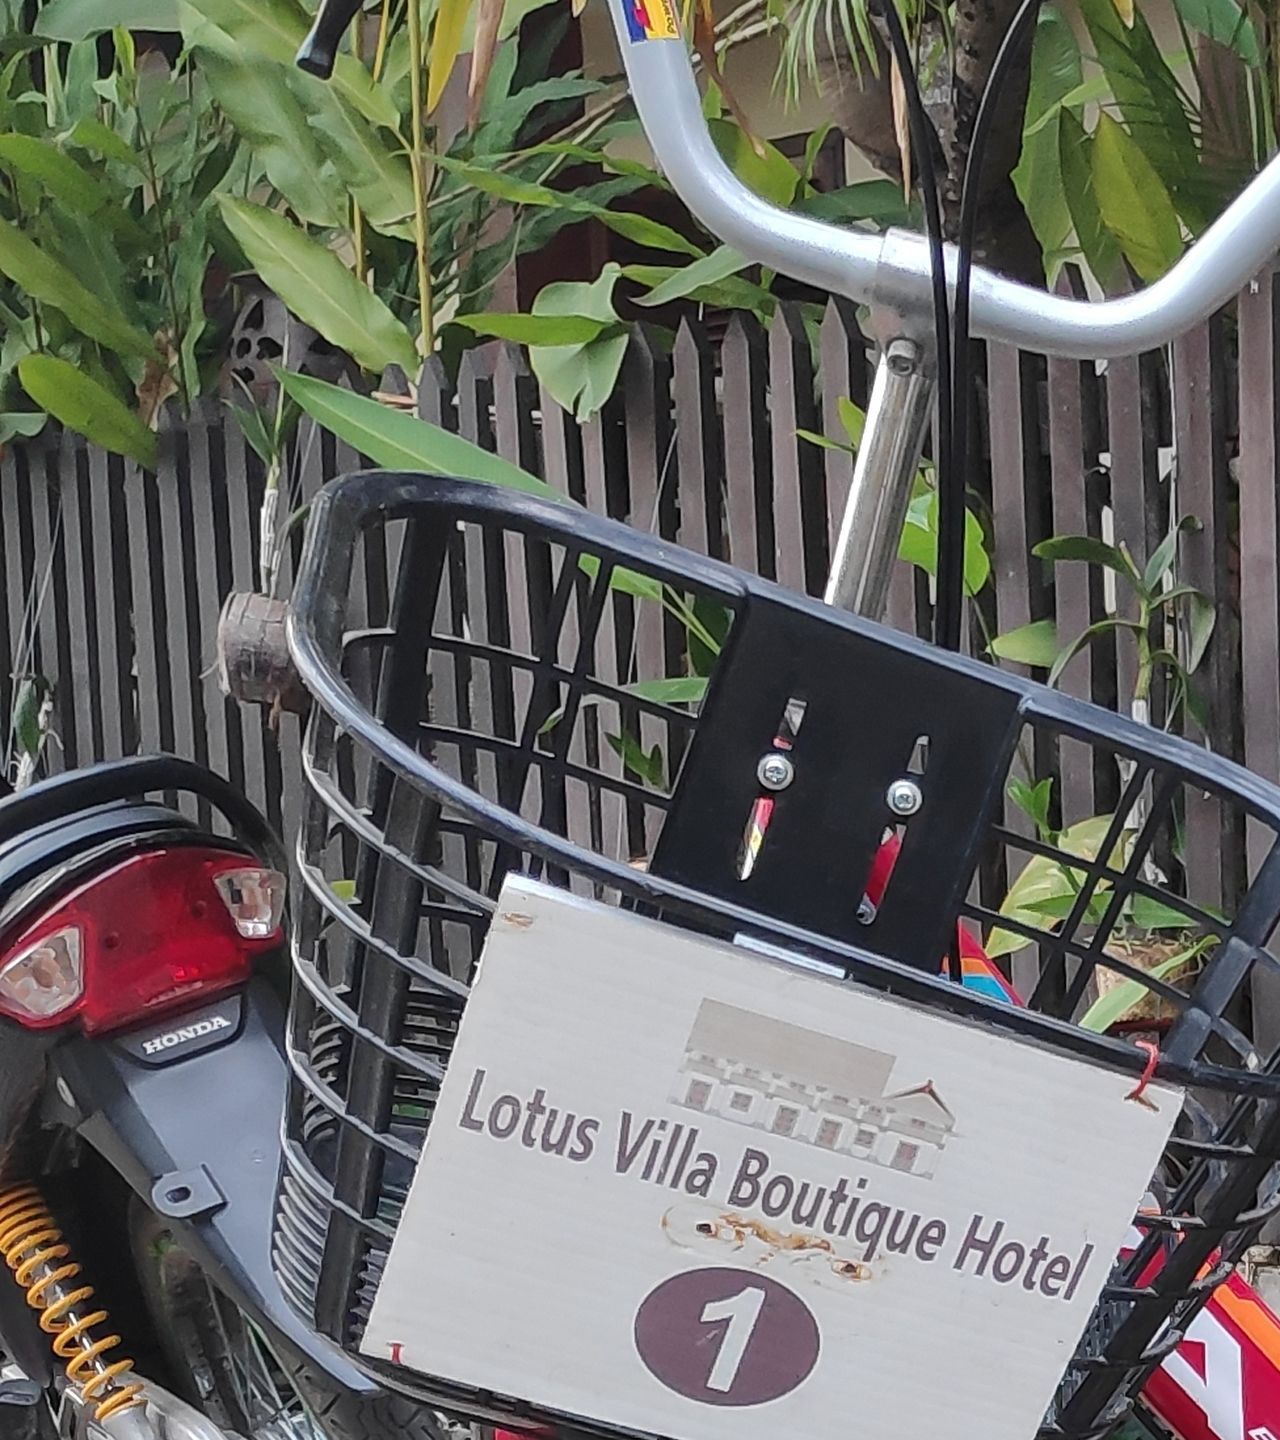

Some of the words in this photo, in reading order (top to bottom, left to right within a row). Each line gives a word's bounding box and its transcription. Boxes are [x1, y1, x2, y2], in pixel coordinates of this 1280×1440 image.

[142, 1016, 232, 1055] HONDA
[458, 1067, 601, 1162] Lotus
[614, 1110, 719, 1198] Villa
[727, 1147, 947, 1263] Boutique
[952, 1213, 1095, 1302] Hotel
[699, 1286, 767, 1393] 1
